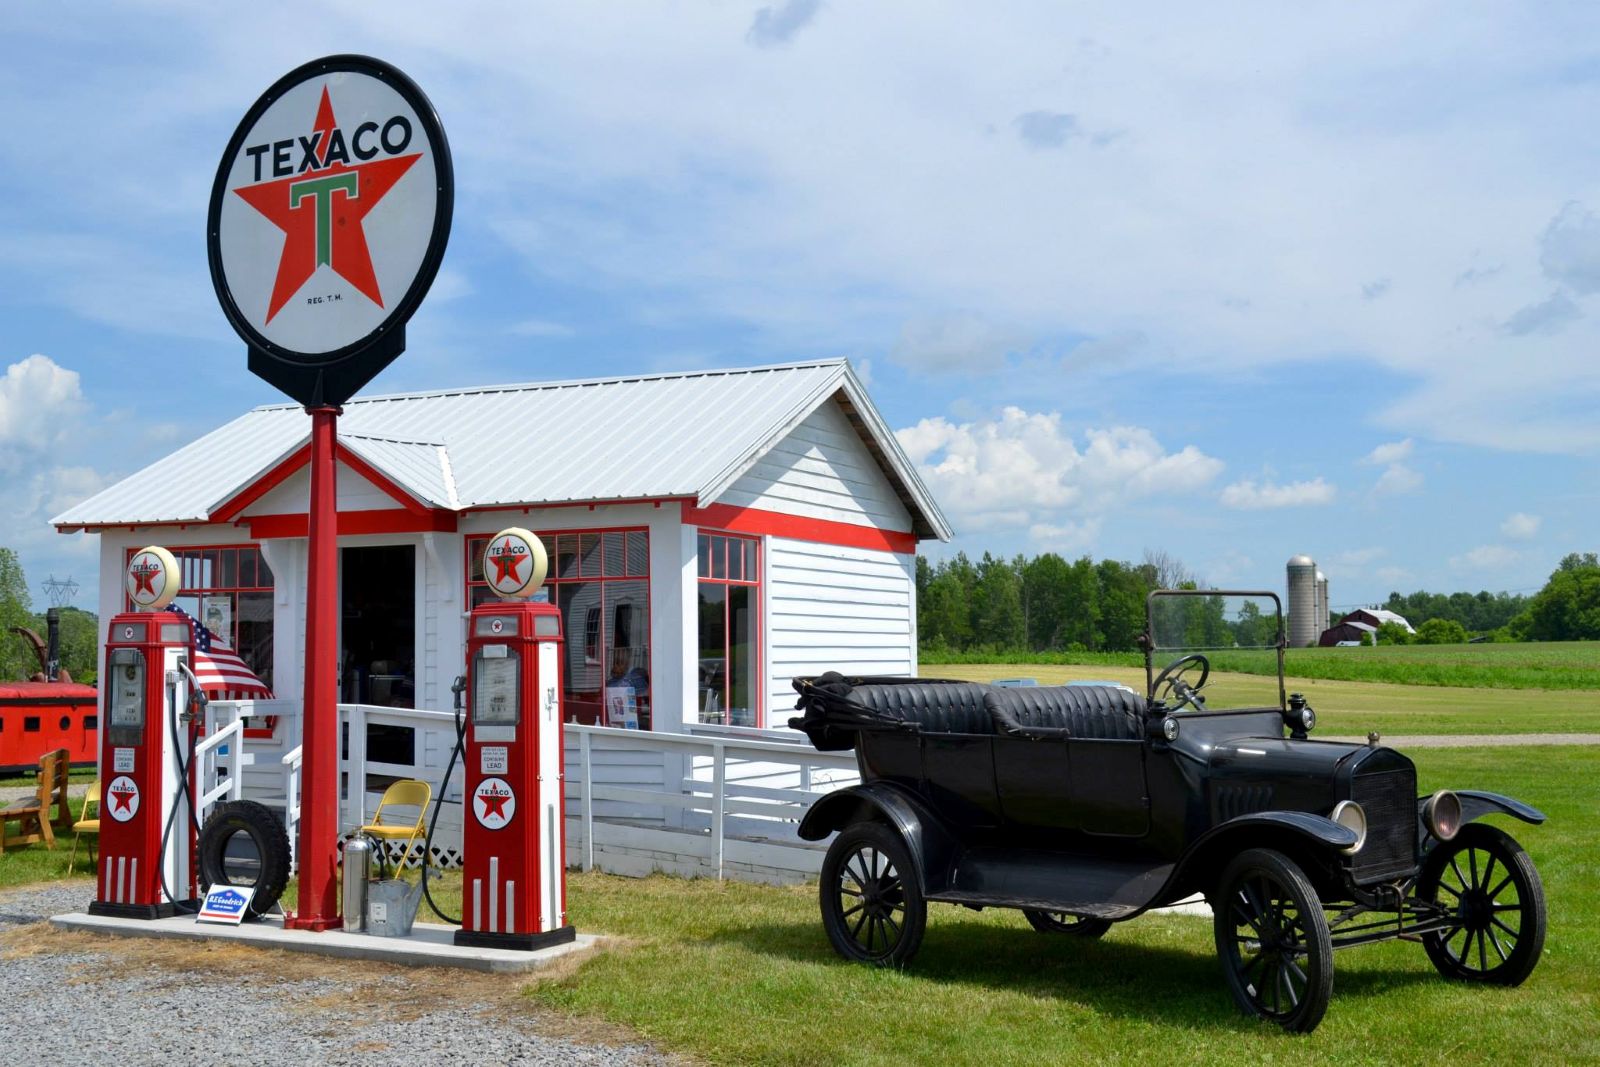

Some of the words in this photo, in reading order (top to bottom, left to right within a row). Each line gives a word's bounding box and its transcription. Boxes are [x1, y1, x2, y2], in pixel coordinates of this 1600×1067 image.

[246, 115, 412, 181] TEXACO
[289, 170, 359, 269] T
[307, 296, 325, 304] REG.
[491, 546, 525, 555] TEXACO
